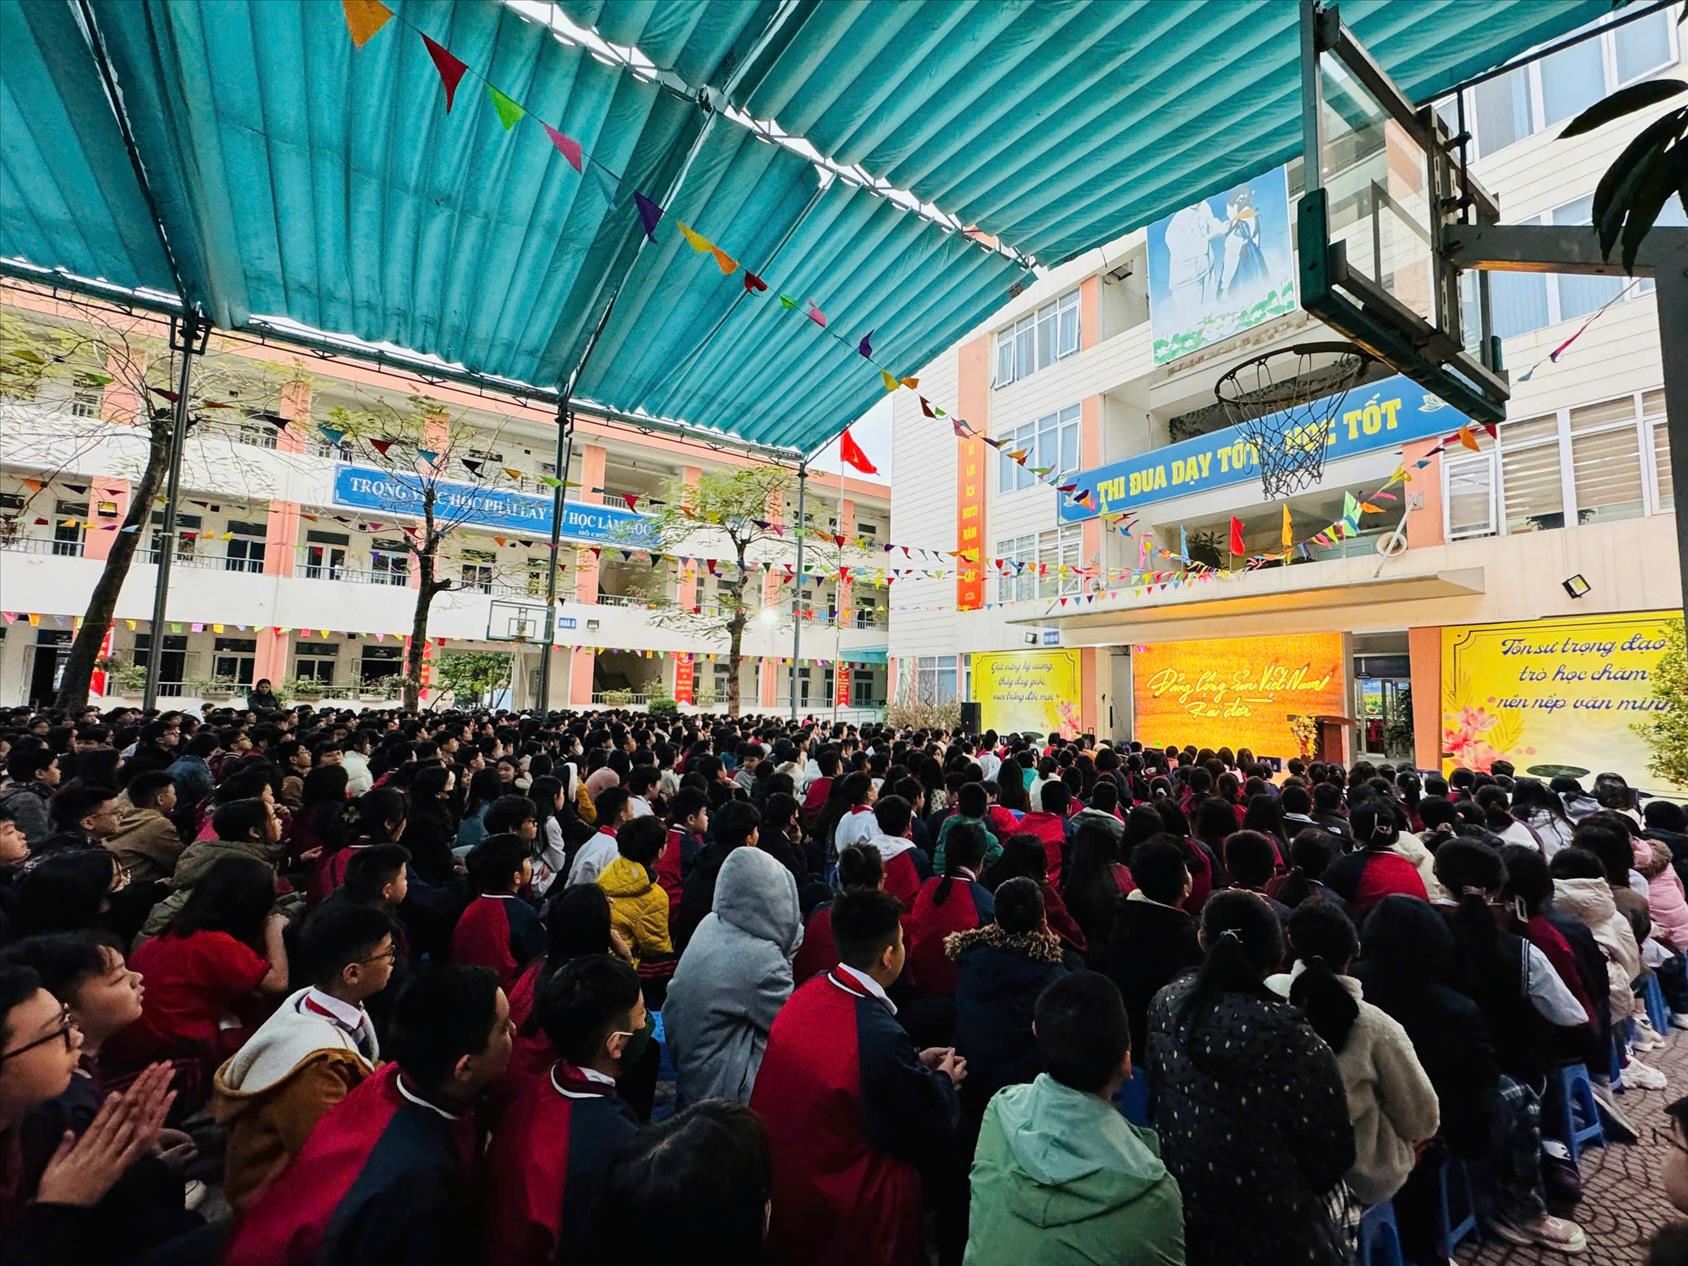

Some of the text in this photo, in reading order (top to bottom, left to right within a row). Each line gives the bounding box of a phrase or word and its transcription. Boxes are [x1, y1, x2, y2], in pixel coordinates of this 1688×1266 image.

[1097, 476, 1125, 504] THI
[1129, 465, 1167, 496] ĐUA
[1172, 452, 1212, 485] DẠY
[1343, 393, 1402, 440] TỐT
[350, 477, 406, 499] TRONG
[569, 511, 596, 529] HỌC
[1501, 633, 1667, 657] Tôn sư trọng đạo
[1519, 663, 1648, 684] trò học chăm
[1572, 696, 1614, 709] văn
